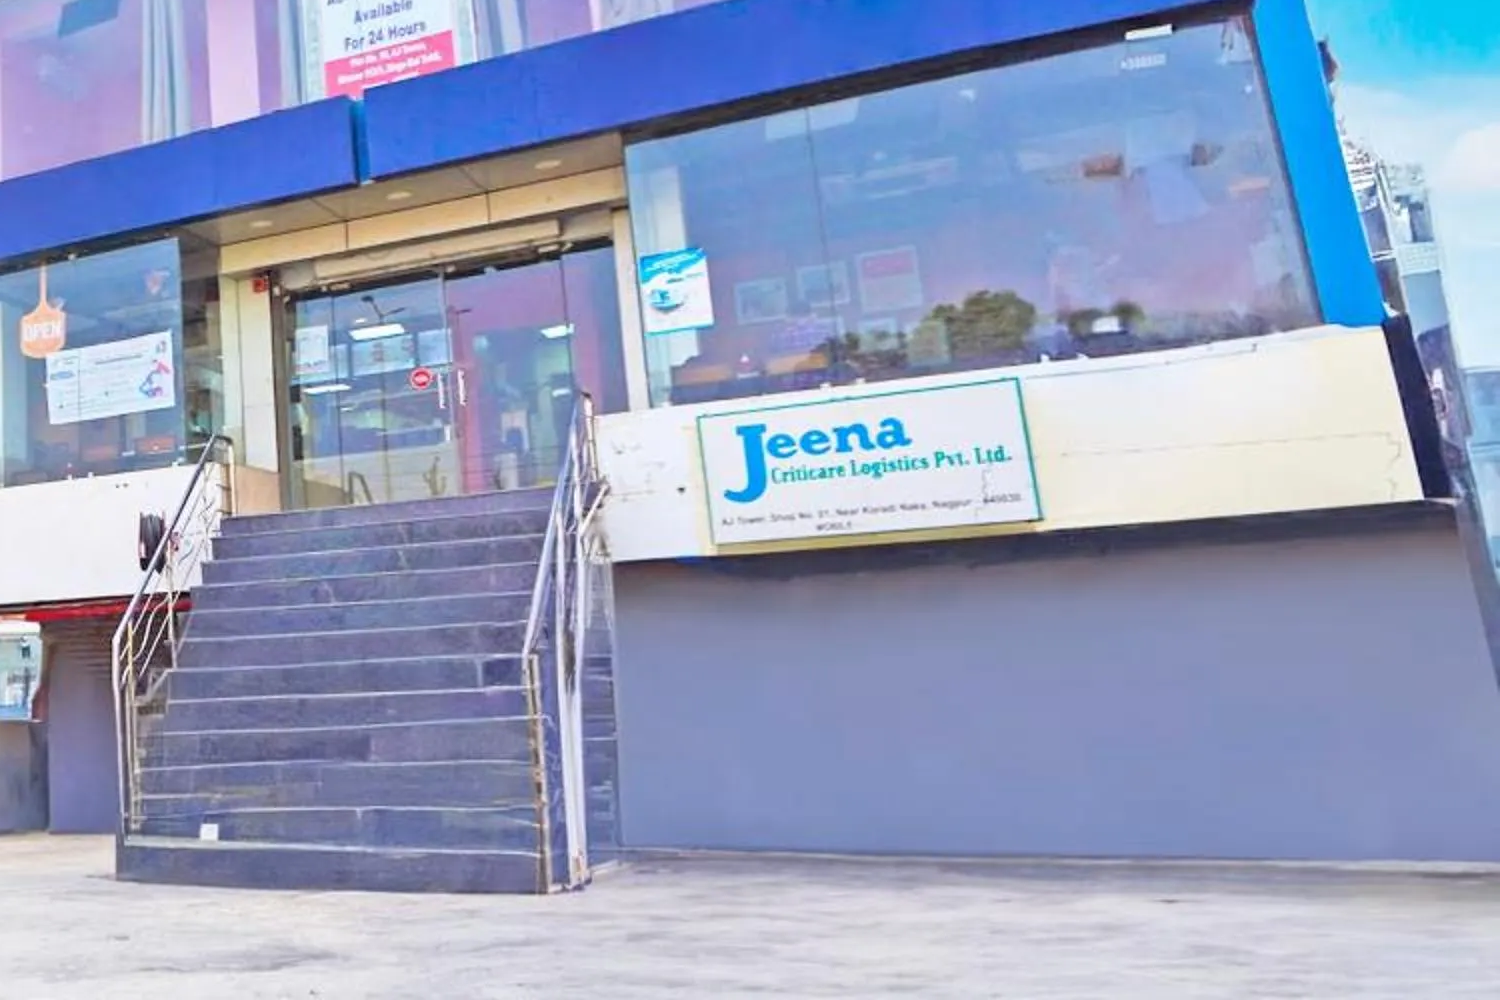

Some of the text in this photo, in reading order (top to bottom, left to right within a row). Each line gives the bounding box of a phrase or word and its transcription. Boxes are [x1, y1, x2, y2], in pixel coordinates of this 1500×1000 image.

[354, 0, 413, 24] Available
[344, 21, 426, 51] For 24 Hours
[723, 416, 912, 505] Jeena
[771, 445, 1013, 485] Criticare Logistics Pvt. Ltd.
